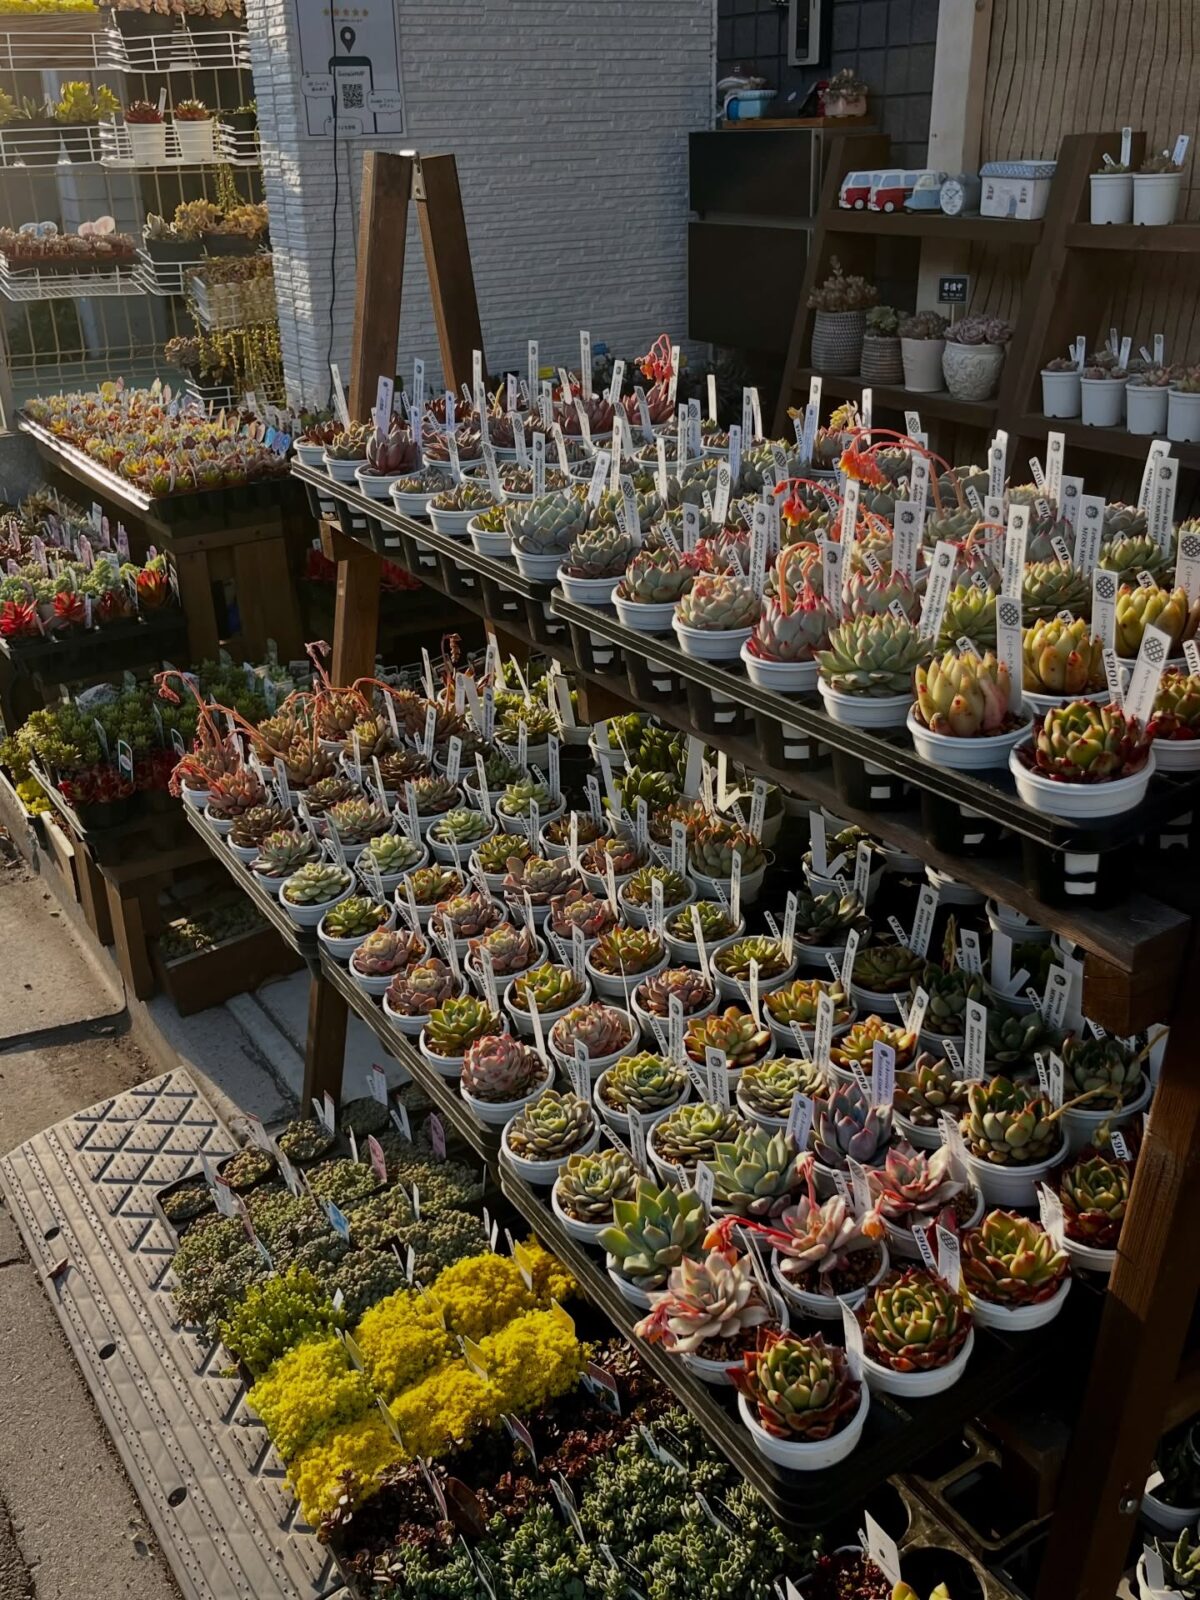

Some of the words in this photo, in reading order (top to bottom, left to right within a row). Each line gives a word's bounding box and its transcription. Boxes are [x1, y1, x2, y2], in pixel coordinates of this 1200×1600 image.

[1056, 538, 1071, 562] ¥90
[1105, 651, 1120, 687] ¥900
[852, 1063, 868, 1090] ¥900
[914, 1228, 933, 1260] ¥900
